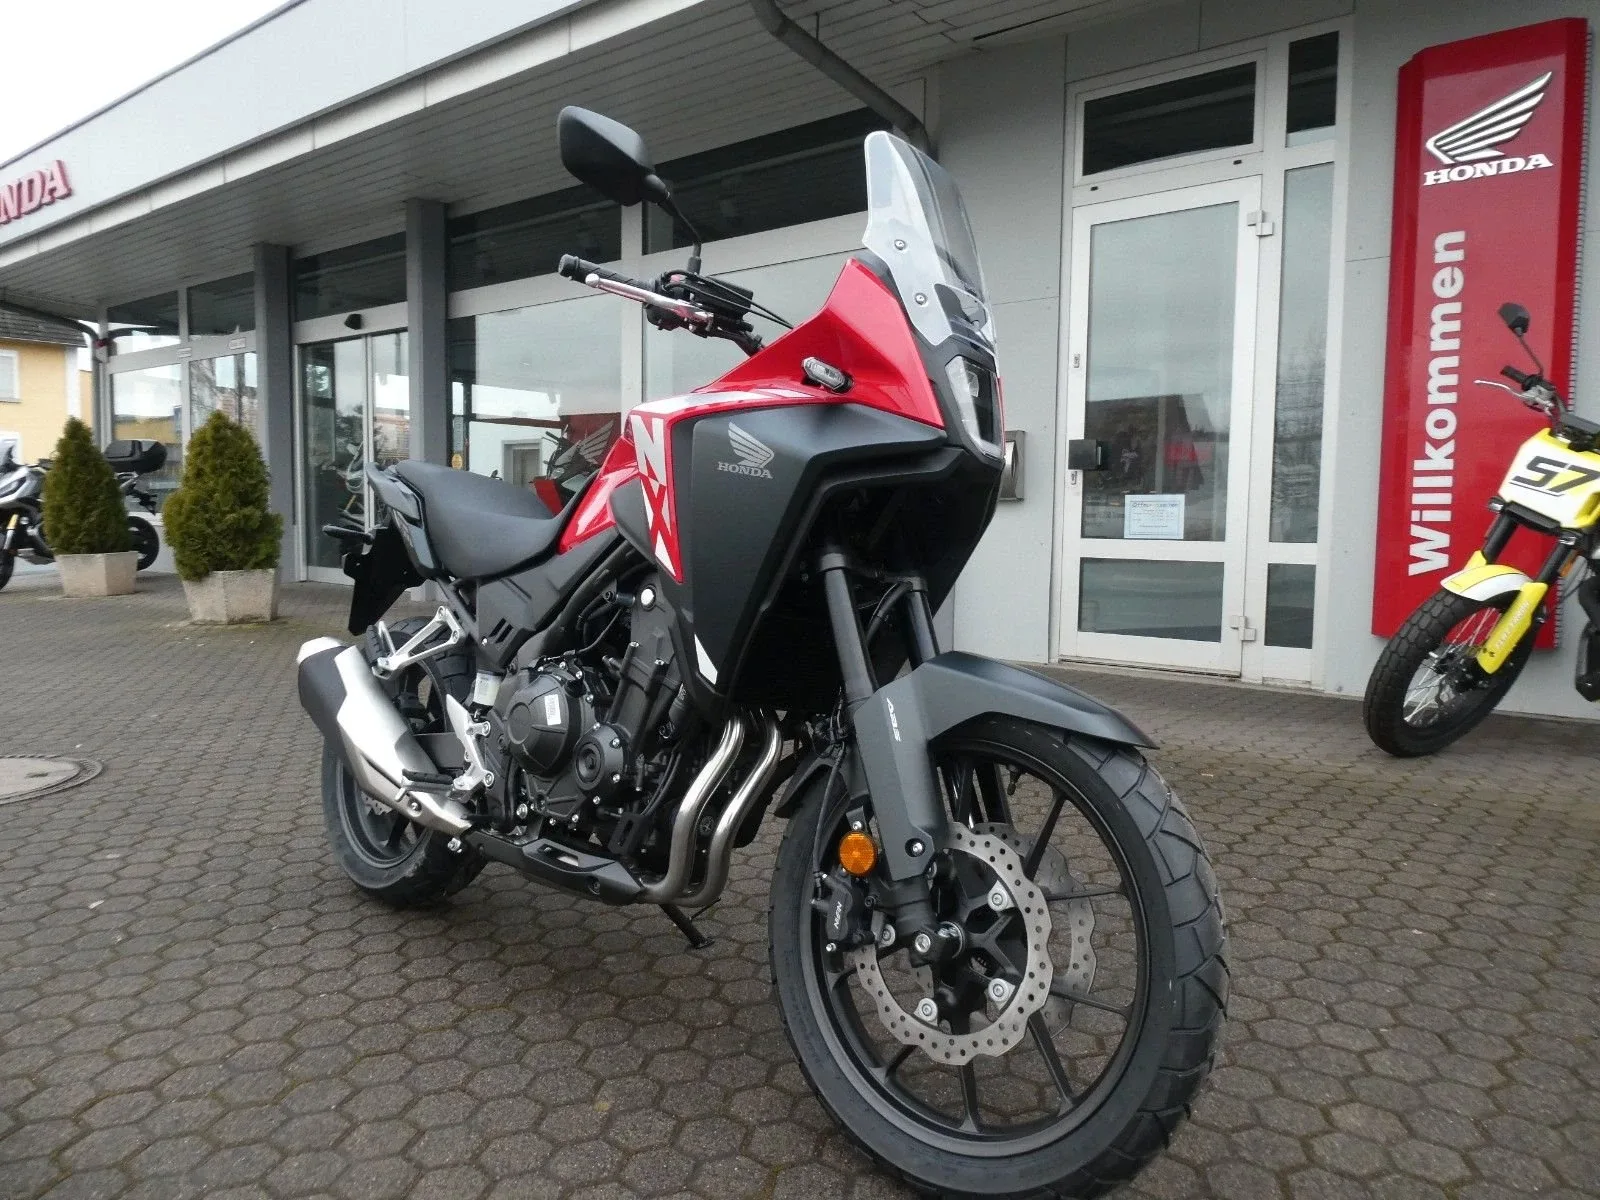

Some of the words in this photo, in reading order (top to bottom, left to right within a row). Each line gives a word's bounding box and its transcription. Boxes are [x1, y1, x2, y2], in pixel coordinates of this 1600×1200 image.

[1423, 153, 1554, 186] HONDA
[1408, 230, 1466, 576] Willkommen
[717, 461, 773, 479] HONDA
